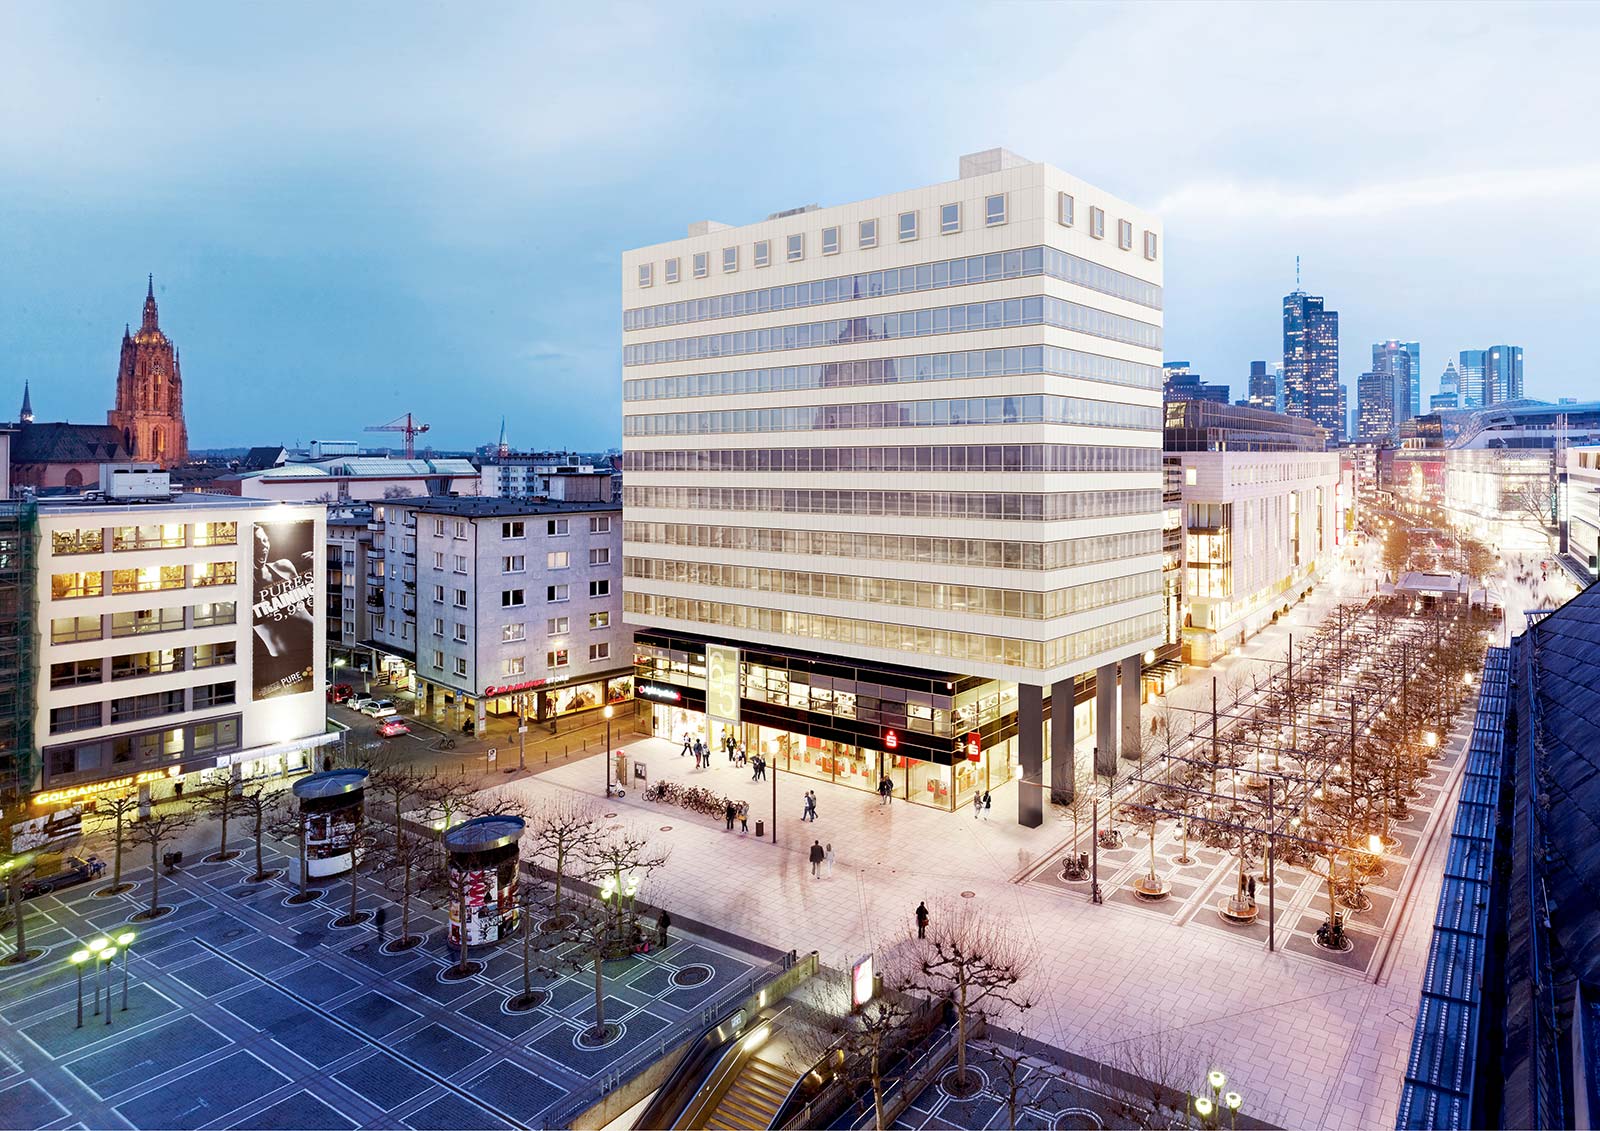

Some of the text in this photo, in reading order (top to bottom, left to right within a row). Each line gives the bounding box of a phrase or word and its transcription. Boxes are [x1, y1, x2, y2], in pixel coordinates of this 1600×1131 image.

[259, 571, 314, 602] PURES
[280, 671, 302, 685] PURE
[35, 777, 134, 804] GOLDANKAUF
